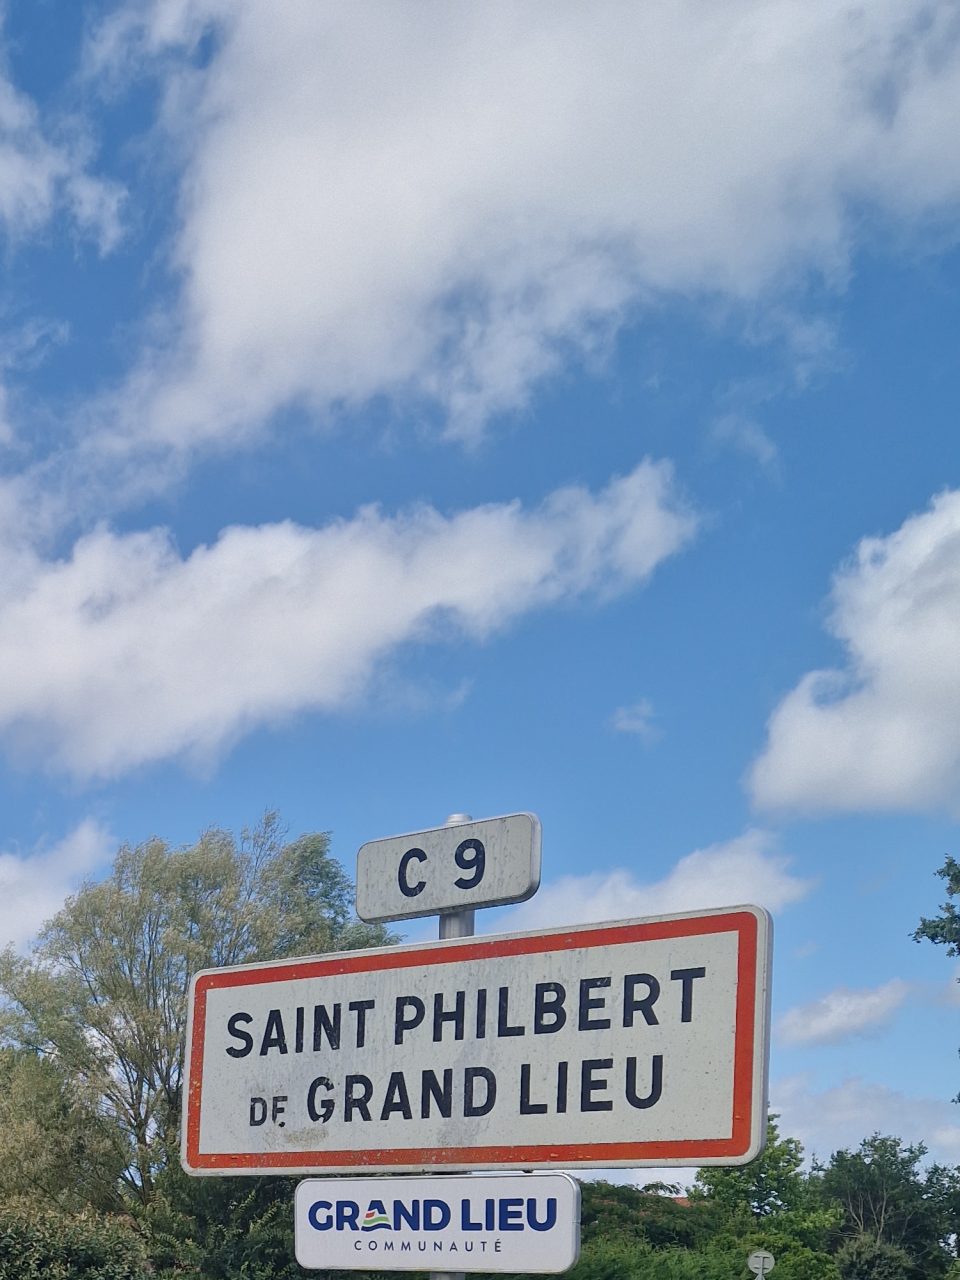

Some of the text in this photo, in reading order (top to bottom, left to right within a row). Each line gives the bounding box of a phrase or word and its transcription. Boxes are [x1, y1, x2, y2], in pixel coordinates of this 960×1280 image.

[398, 838, 486, 898] C 9
[226, 966, 706, 1059] SAINT PHILBERT
[249, 1055, 664, 1127] DE GRAND LIEU
[308, 1198, 557, 1232] GRAND LIEU
[354, 1238, 502, 1252] COMMUNAUTÉ
